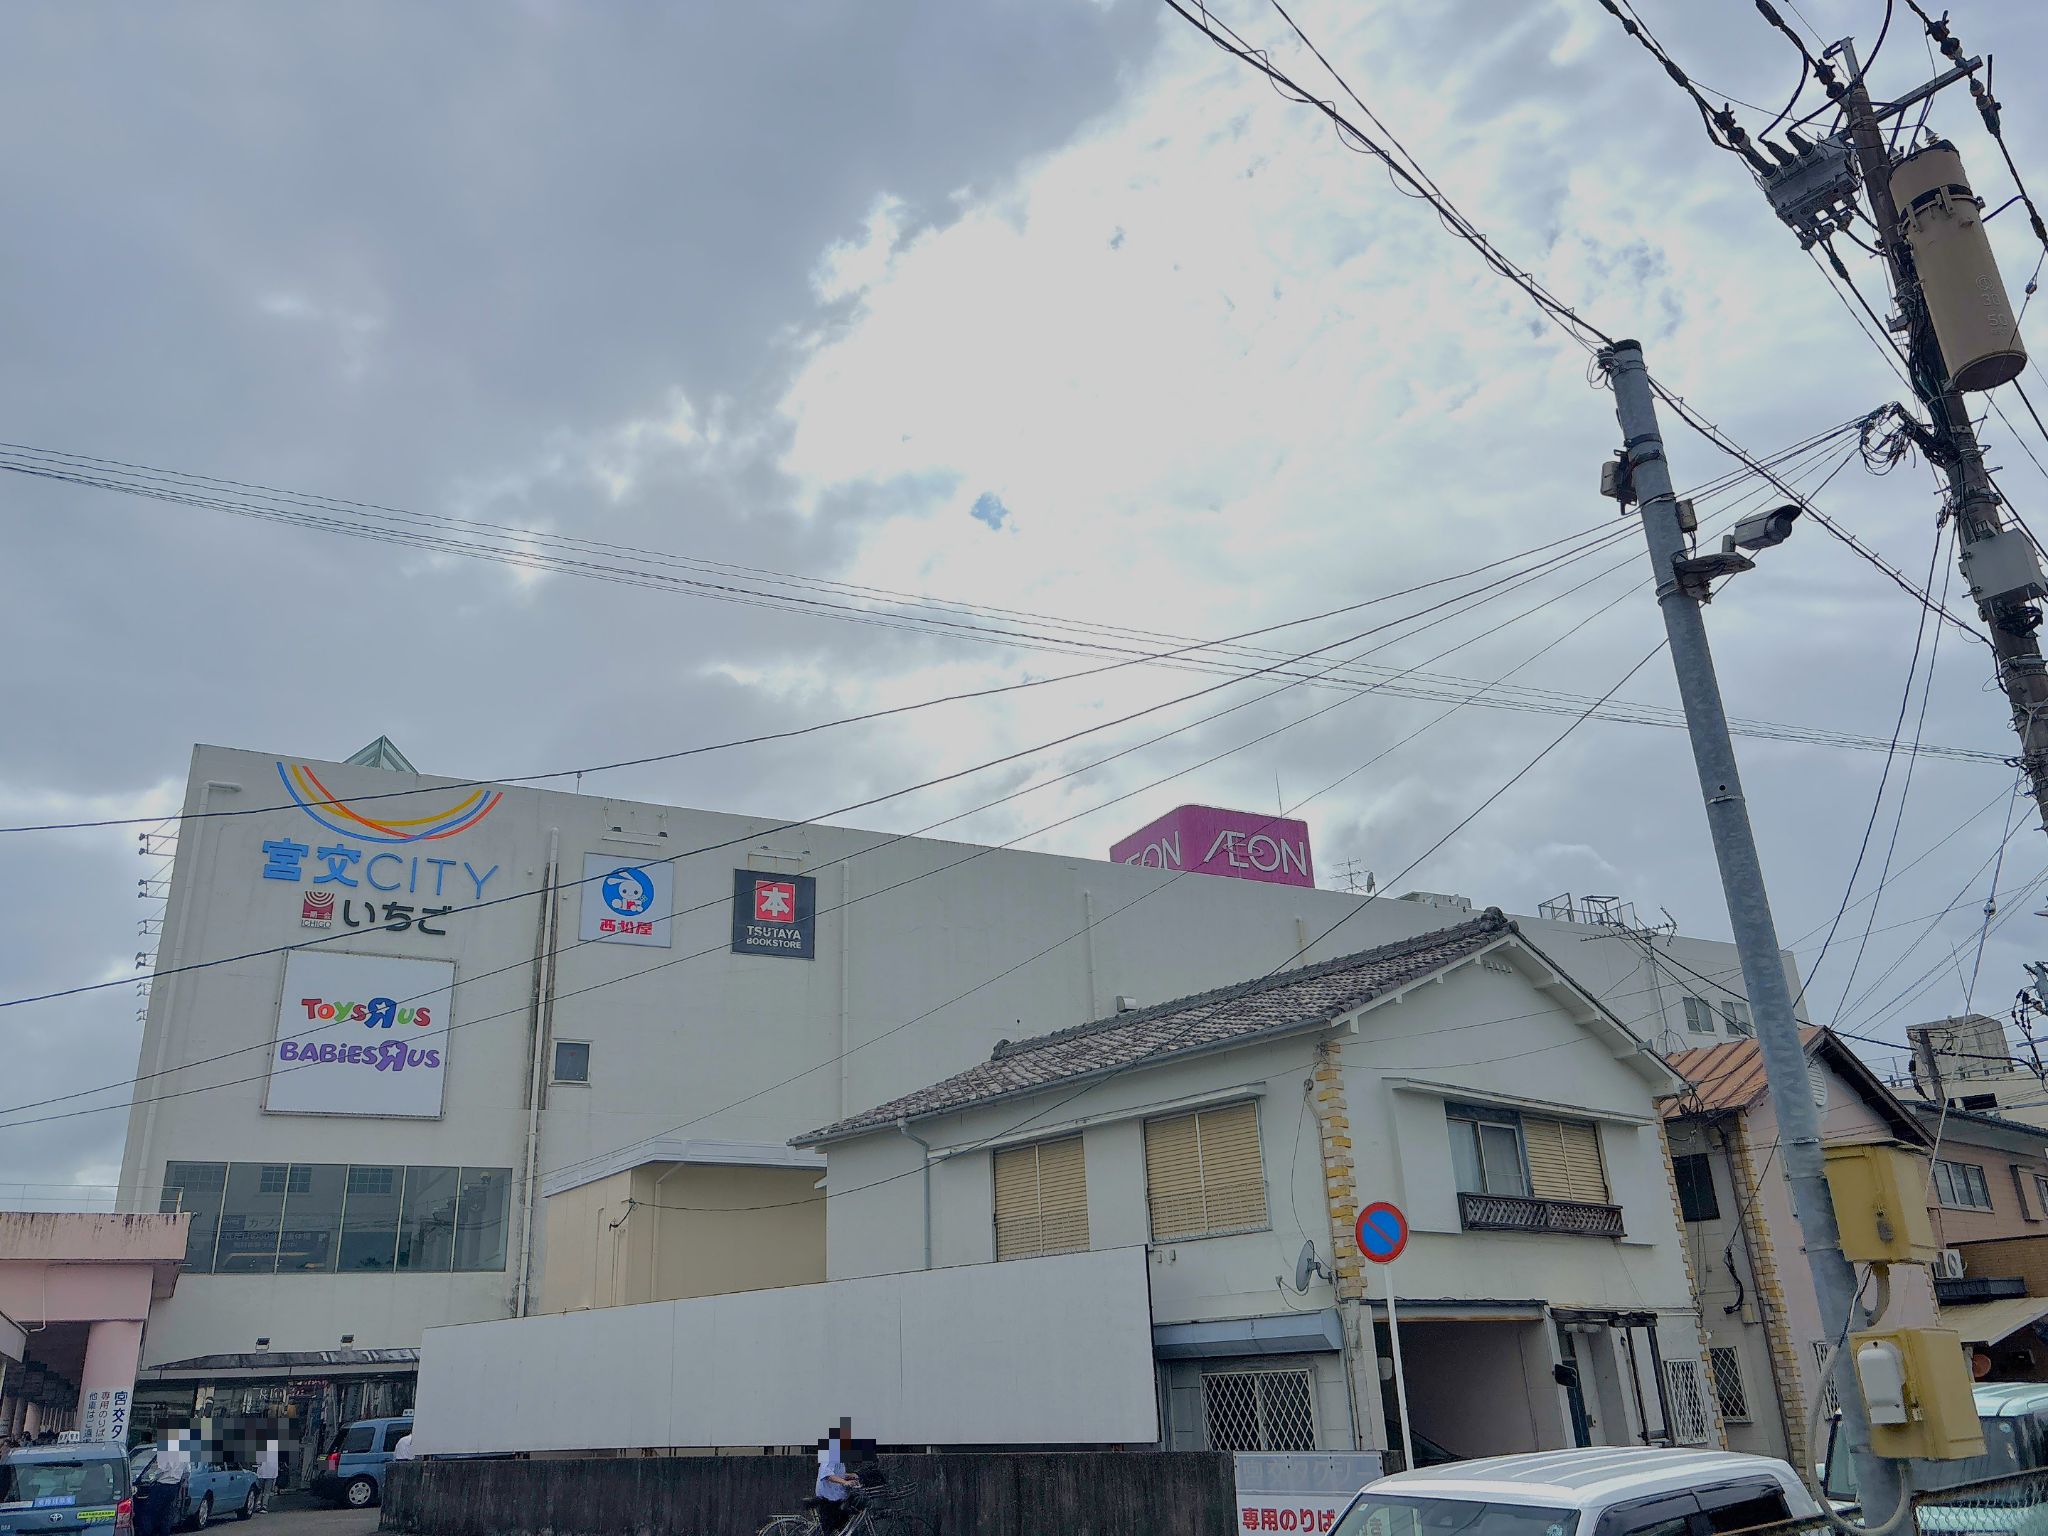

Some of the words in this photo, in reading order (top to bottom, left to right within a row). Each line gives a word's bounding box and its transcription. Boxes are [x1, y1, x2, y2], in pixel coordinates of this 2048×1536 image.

[262, 838, 499, 899] 宮交CITY
[760, 886, 790, 917] 本
[301, 919, 332, 929] ICHIGO
[343, 899, 452, 936] いちご
[600, 918, 653, 935] 西松屋
[746, 926, 801, 941] TSUTAYA
[746, 937, 802, 949] BOOKSTORE
[95, 1391, 111, 1442] 専用のりば
[111, 1390, 128, 1439] 宮交タ
[1241, 1507, 1336, 1533] 専用のりば
